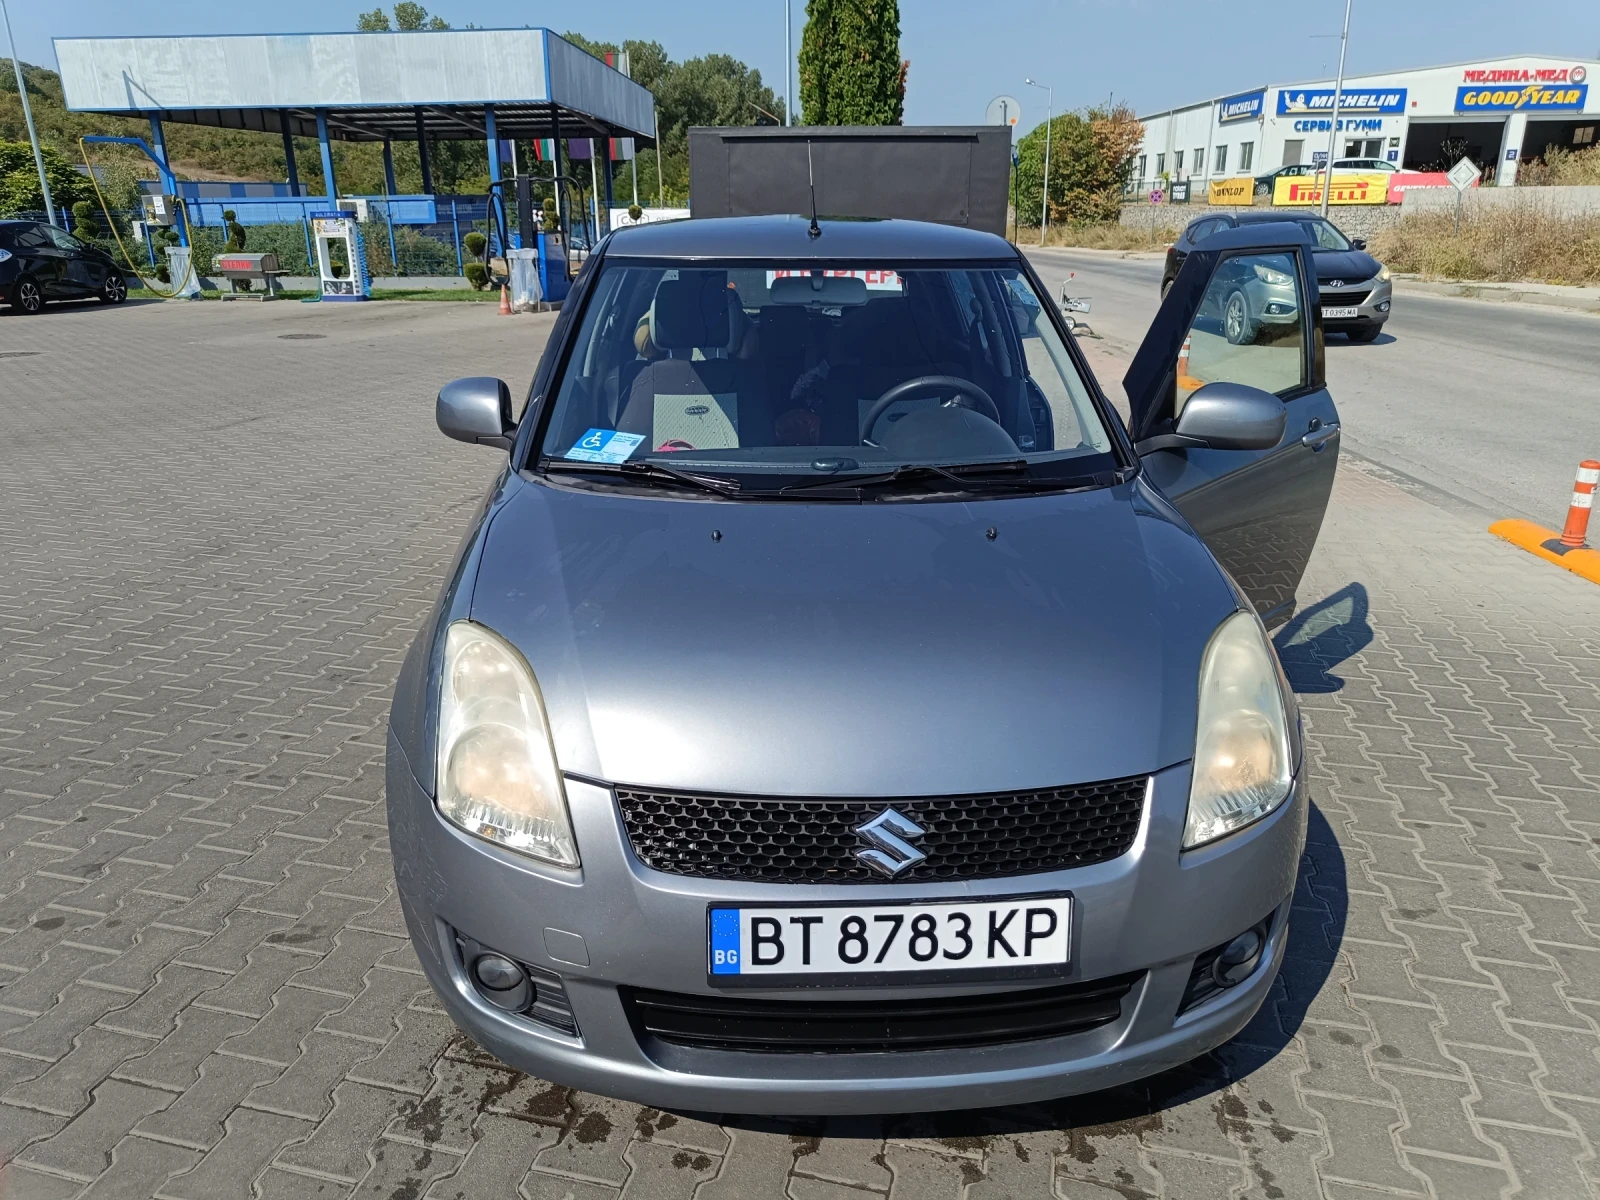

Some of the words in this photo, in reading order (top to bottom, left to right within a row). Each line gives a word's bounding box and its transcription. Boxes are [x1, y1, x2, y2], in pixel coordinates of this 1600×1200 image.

[1463, 69, 1568, 83] МЕДИНА-МЕД
[1228, 99, 1260, 115] MICHELIN
[1308, 95, 1400, 107] MICHELIN
[1294, 120, 1343, 132] СЕРВИЗ
[1345, 119, 1382, 132] ГУМИ
[1508, 151, 1515, 159] 2
[1216, 187, 1244, 197] DUNLOP
[1289, 182, 1368, 201] PIRELLI
[1330, 309, 1346, 317] 0395
[751, 916, 823, 965] BT
[838, 912, 973, 964] 8783
[987, 907, 1057, 959] KP
[714, 949, 738, 965] BG
